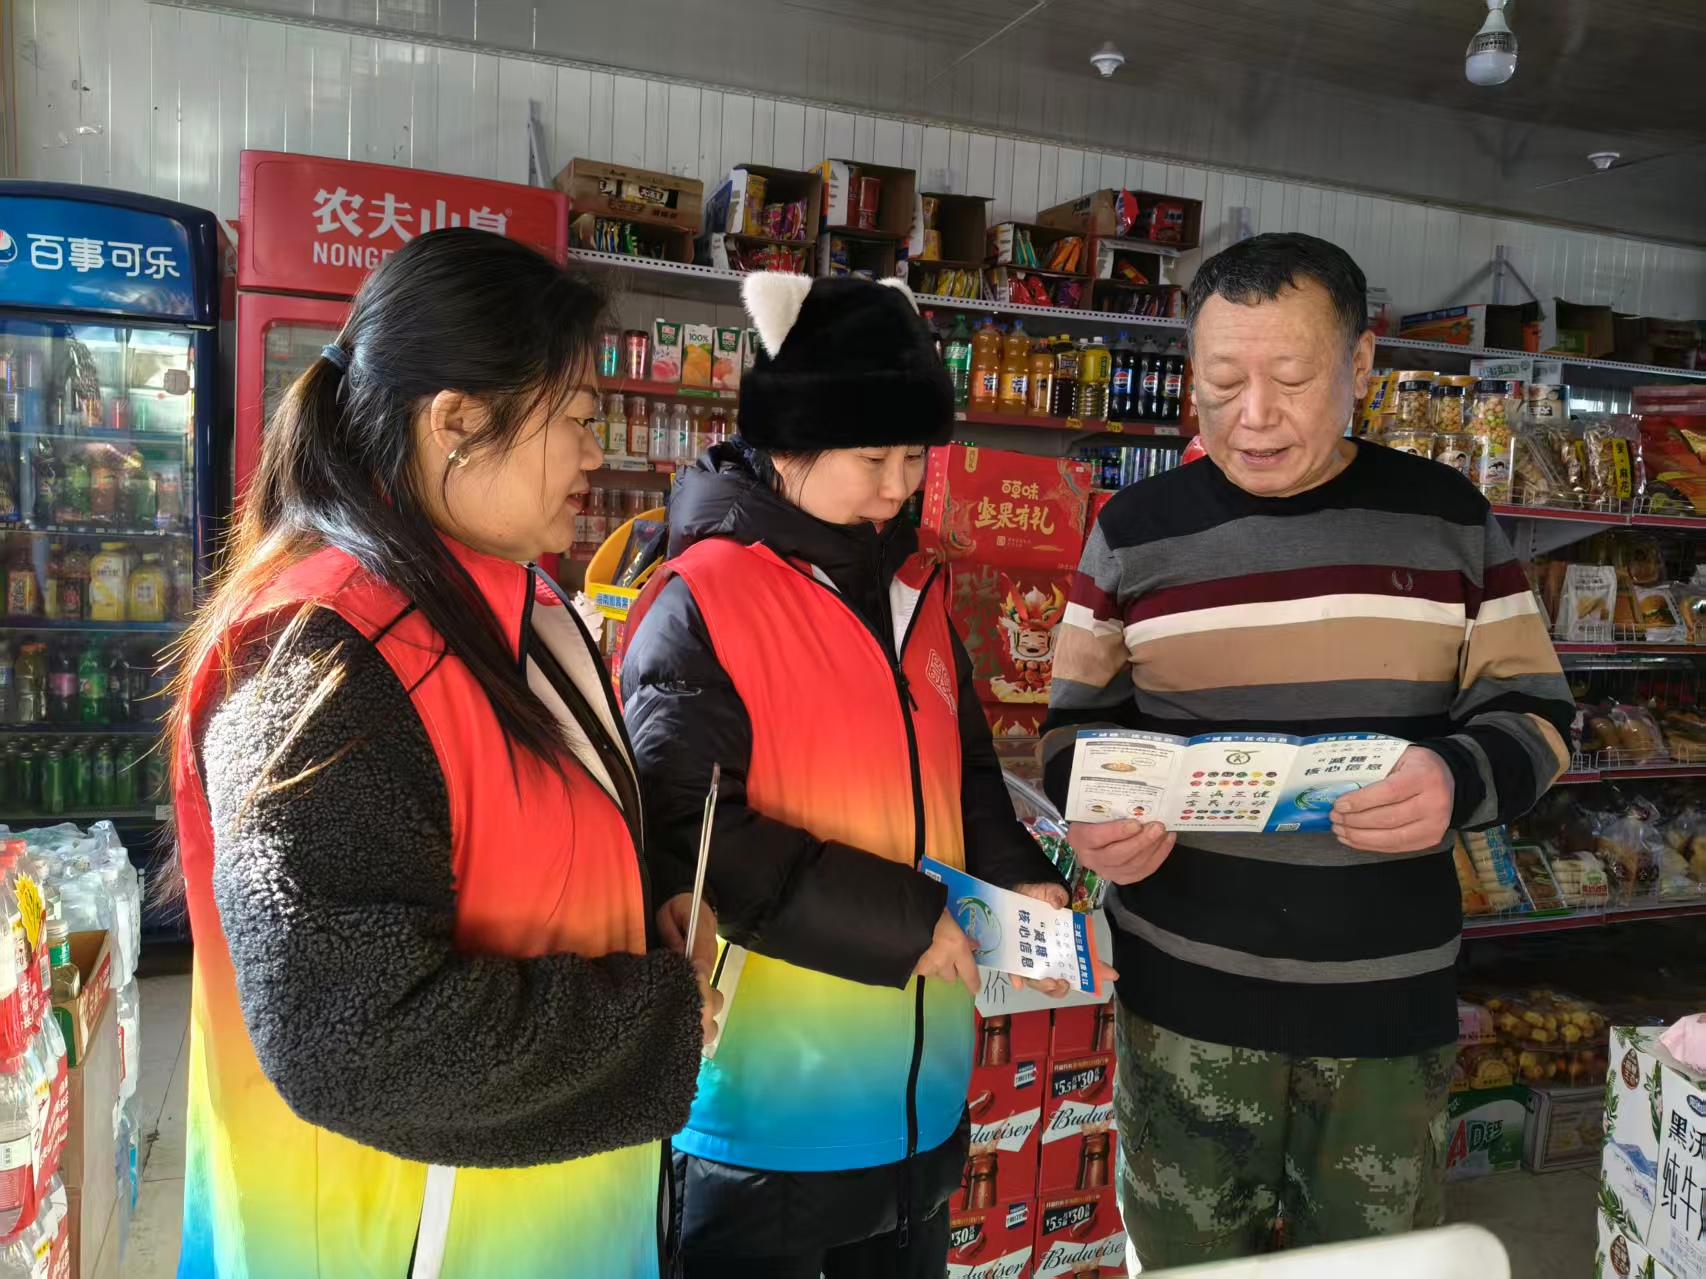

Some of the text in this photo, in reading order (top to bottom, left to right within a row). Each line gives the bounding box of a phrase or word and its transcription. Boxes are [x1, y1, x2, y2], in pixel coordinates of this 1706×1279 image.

[26, 233, 181, 280] 百事可乐
[689, 333, 709, 342] 100%
[1001, 479, 1040, 500] 百草味
[974, 496, 1054, 536] 坚果有礼
[1304, 763, 1383, 776] 核心信息
[1018, 909, 1034, 969] 核心信息
[983, 970, 1010, 1004] 价
[1661, 1147, 1706, 1241] 纯牛
